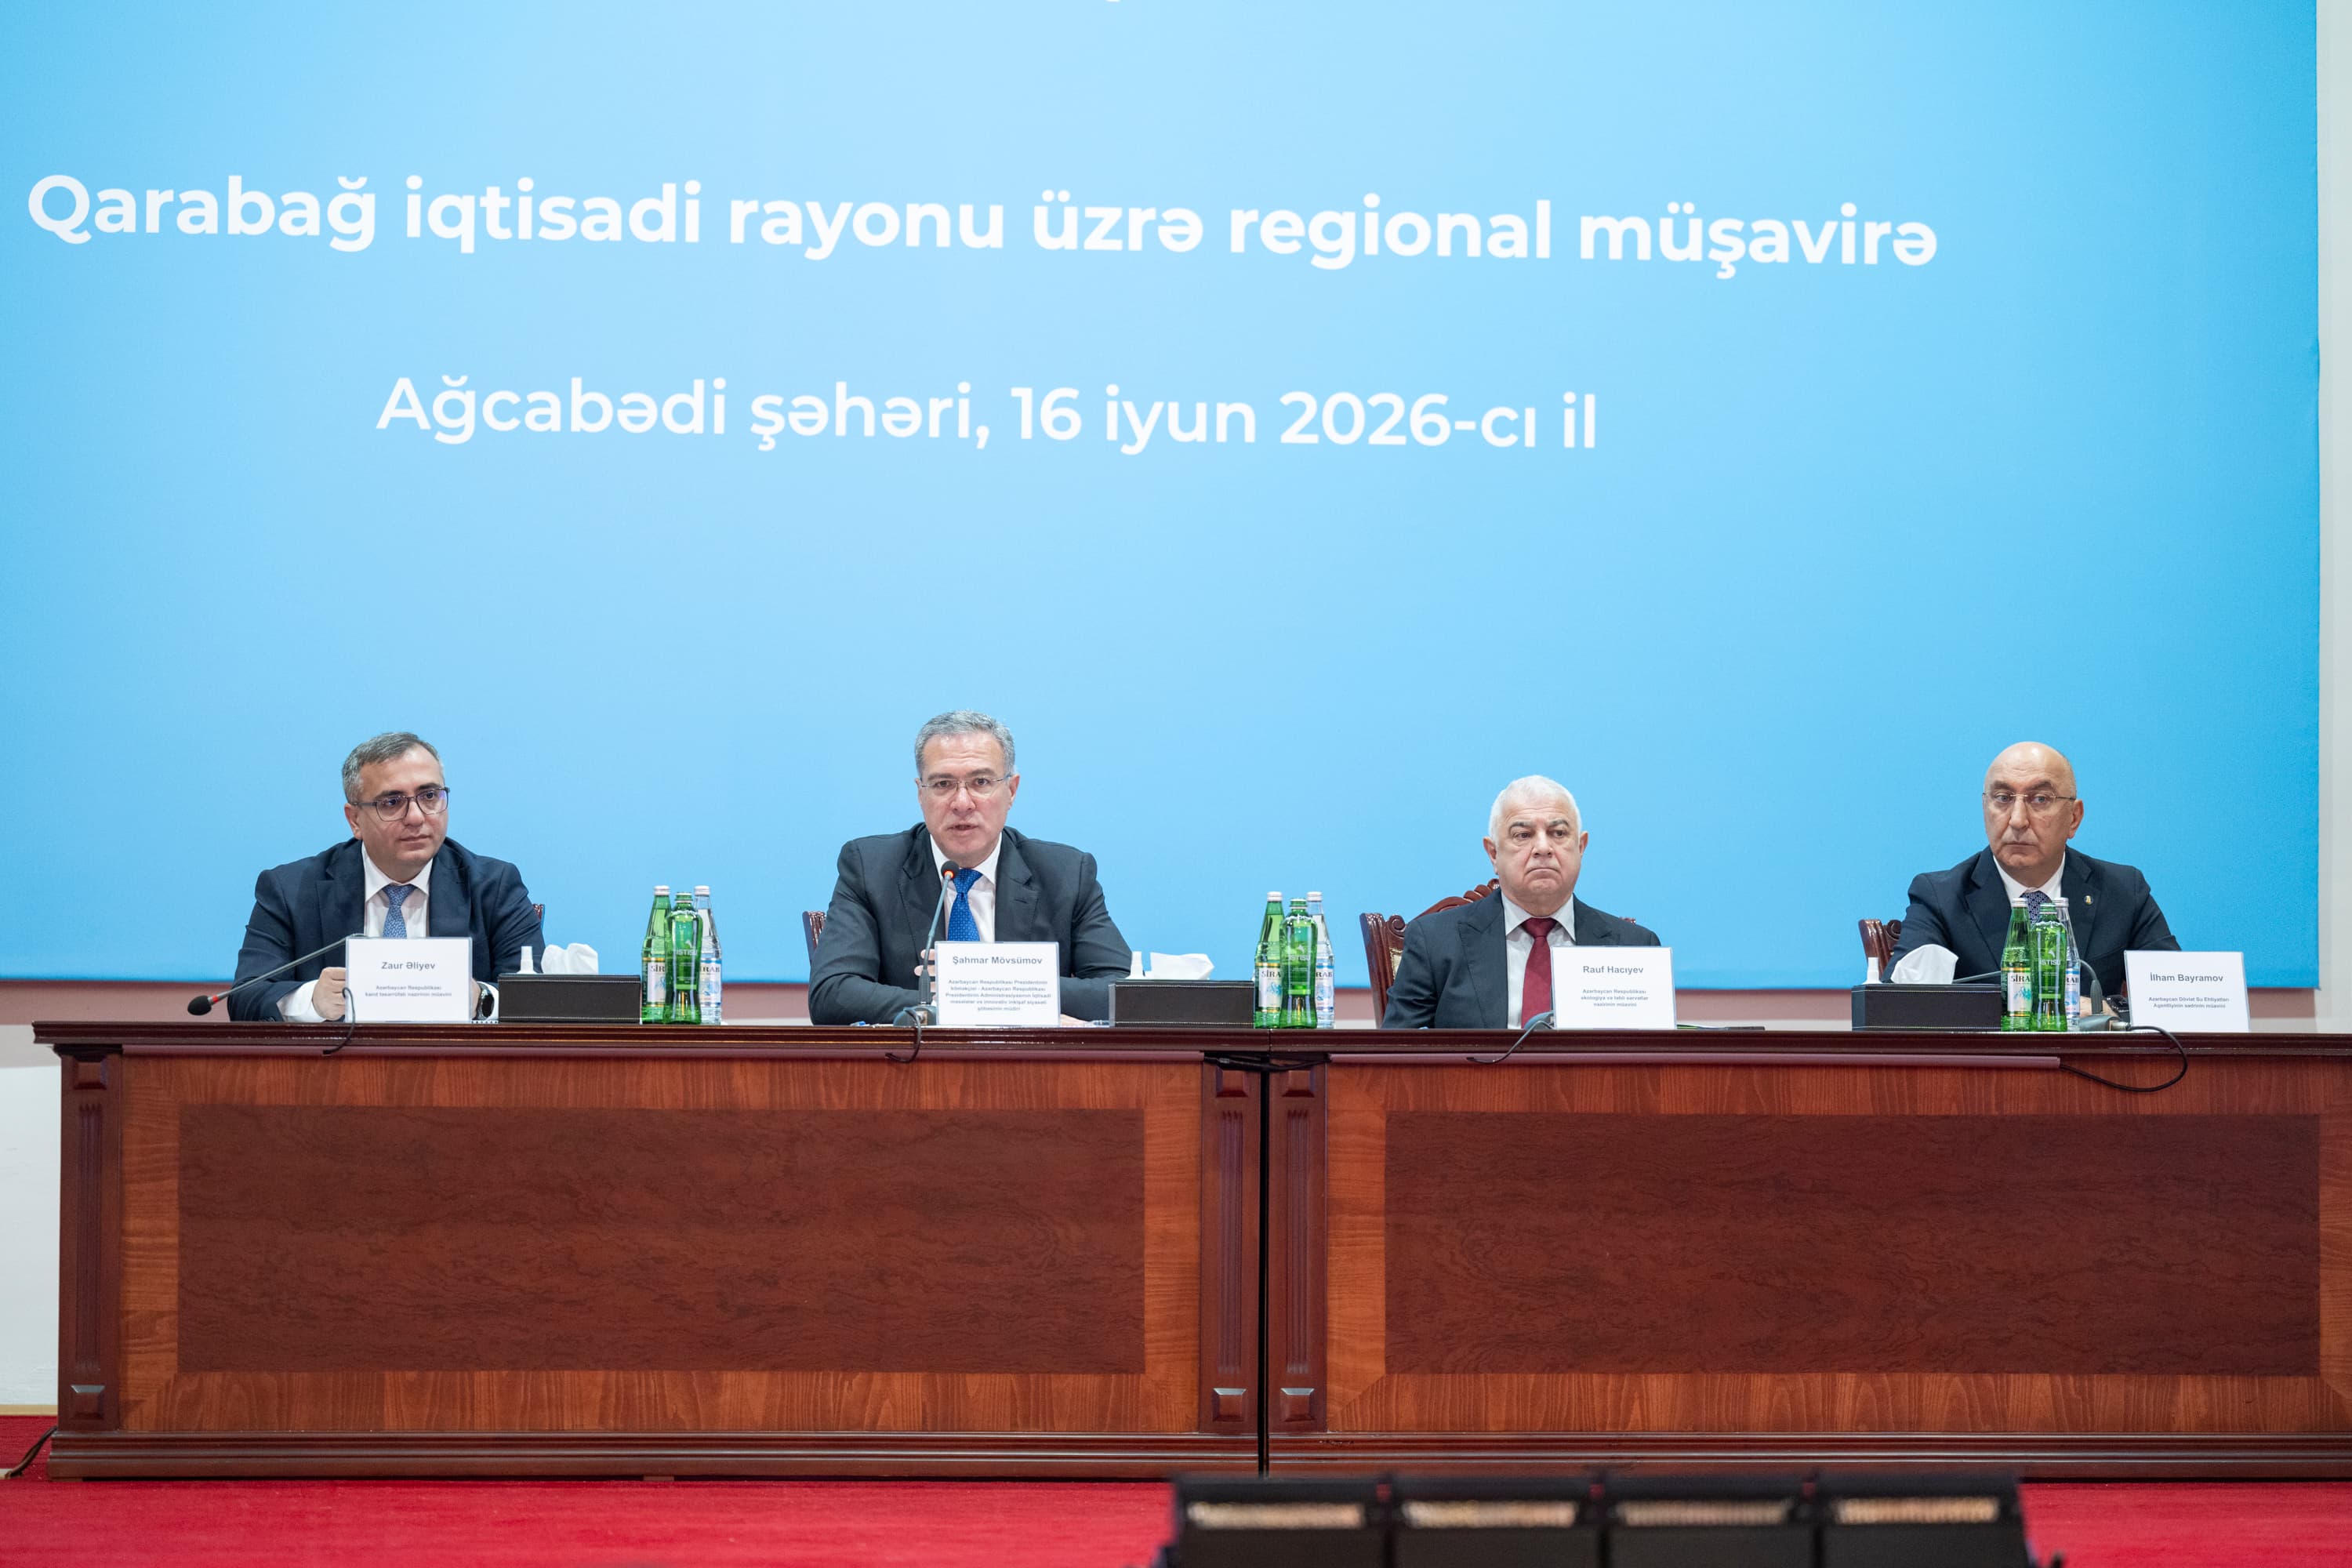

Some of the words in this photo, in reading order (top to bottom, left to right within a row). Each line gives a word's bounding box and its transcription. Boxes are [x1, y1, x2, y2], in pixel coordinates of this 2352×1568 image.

[28, 175, 376, 252] Qarabağ
[406, 175, 701, 254] iqtisadi
[731, 200, 1004, 261] rayonu
[1034, 190, 1203, 252] üzrə
[1231, 193, 1551, 270] regional
[1581, 200, 1937, 279] müşavirə
[376, 375, 726, 445] Ağcabədi
[750, 382, 989, 451] şəhəri,
[1011, 387, 1082, 441] 16
[1106, 384, 1255, 455] iyun
[1279, 391, 1536, 448] 2026-cı
[1563, 391, 1595, 449] il
[406, 961, 435, 971] Əliyev
[1607, 966, 1643, 975] Hacıyev
[2011, 974, 2031, 982] SİRA
[2151, 972, 2175, 982] İlham
[2178, 974, 2223, 983] Bayramov
